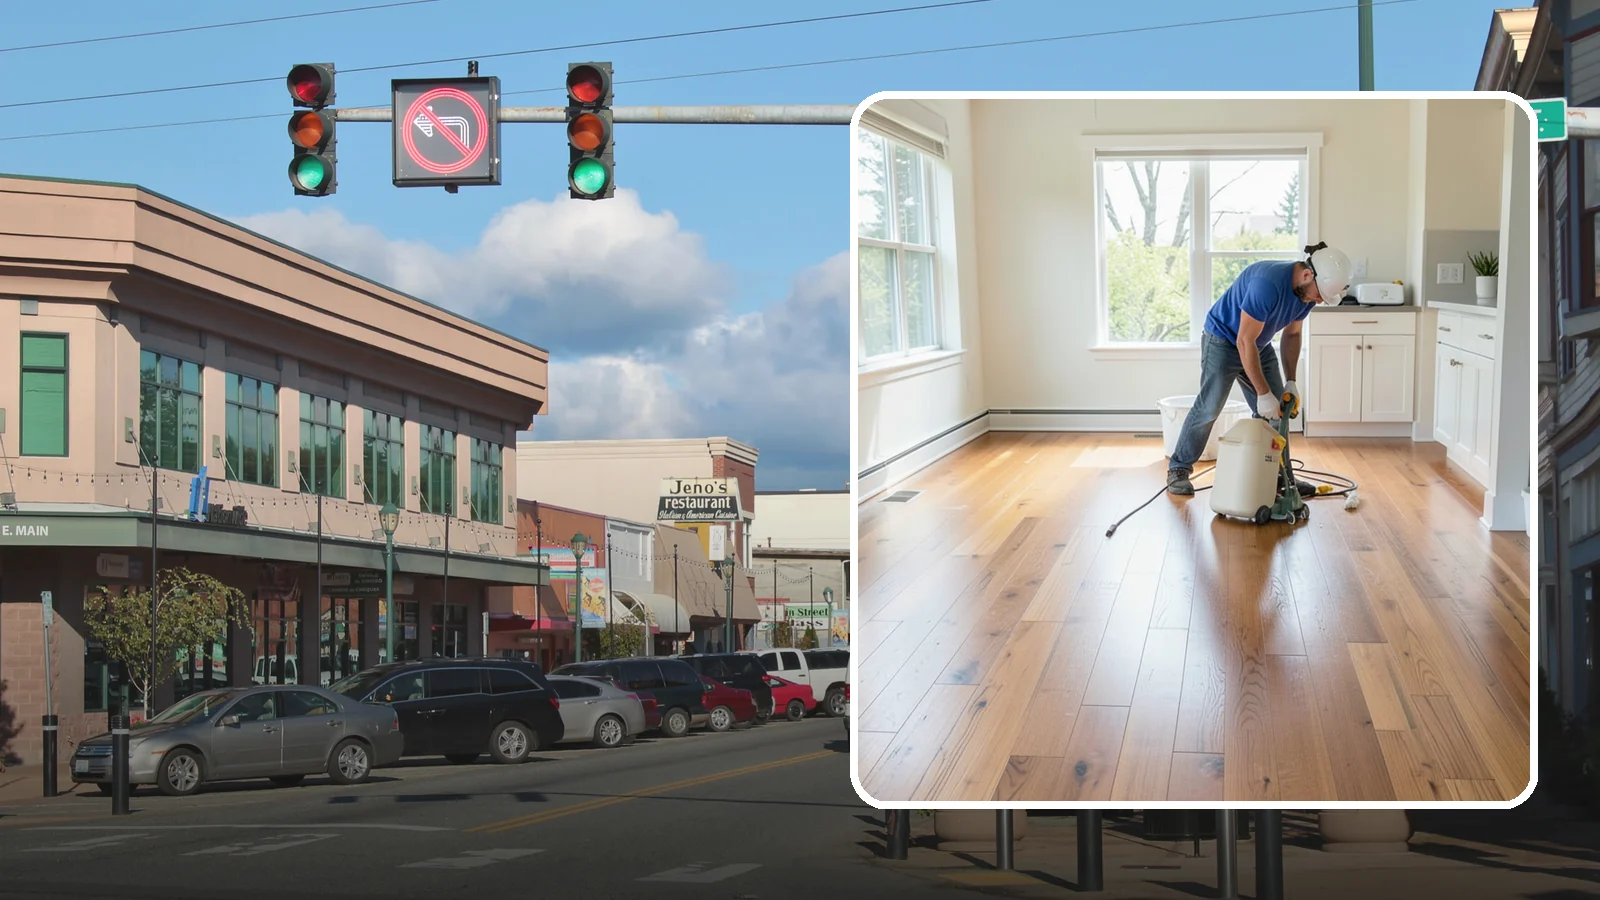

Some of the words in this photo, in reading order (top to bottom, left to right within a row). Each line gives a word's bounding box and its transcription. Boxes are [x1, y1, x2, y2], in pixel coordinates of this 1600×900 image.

[670, 480, 727, 494] Jeno's
[665, 496, 731, 509] restaurant
[658, 510, 681, 520] Italian
[686, 510, 715, 519] American
[715, 509, 737, 519] Cuisine
[2, 525, 13, 536] E.
[15, 525, 49, 536] MAIN
[797, 607, 828, 617] Street
